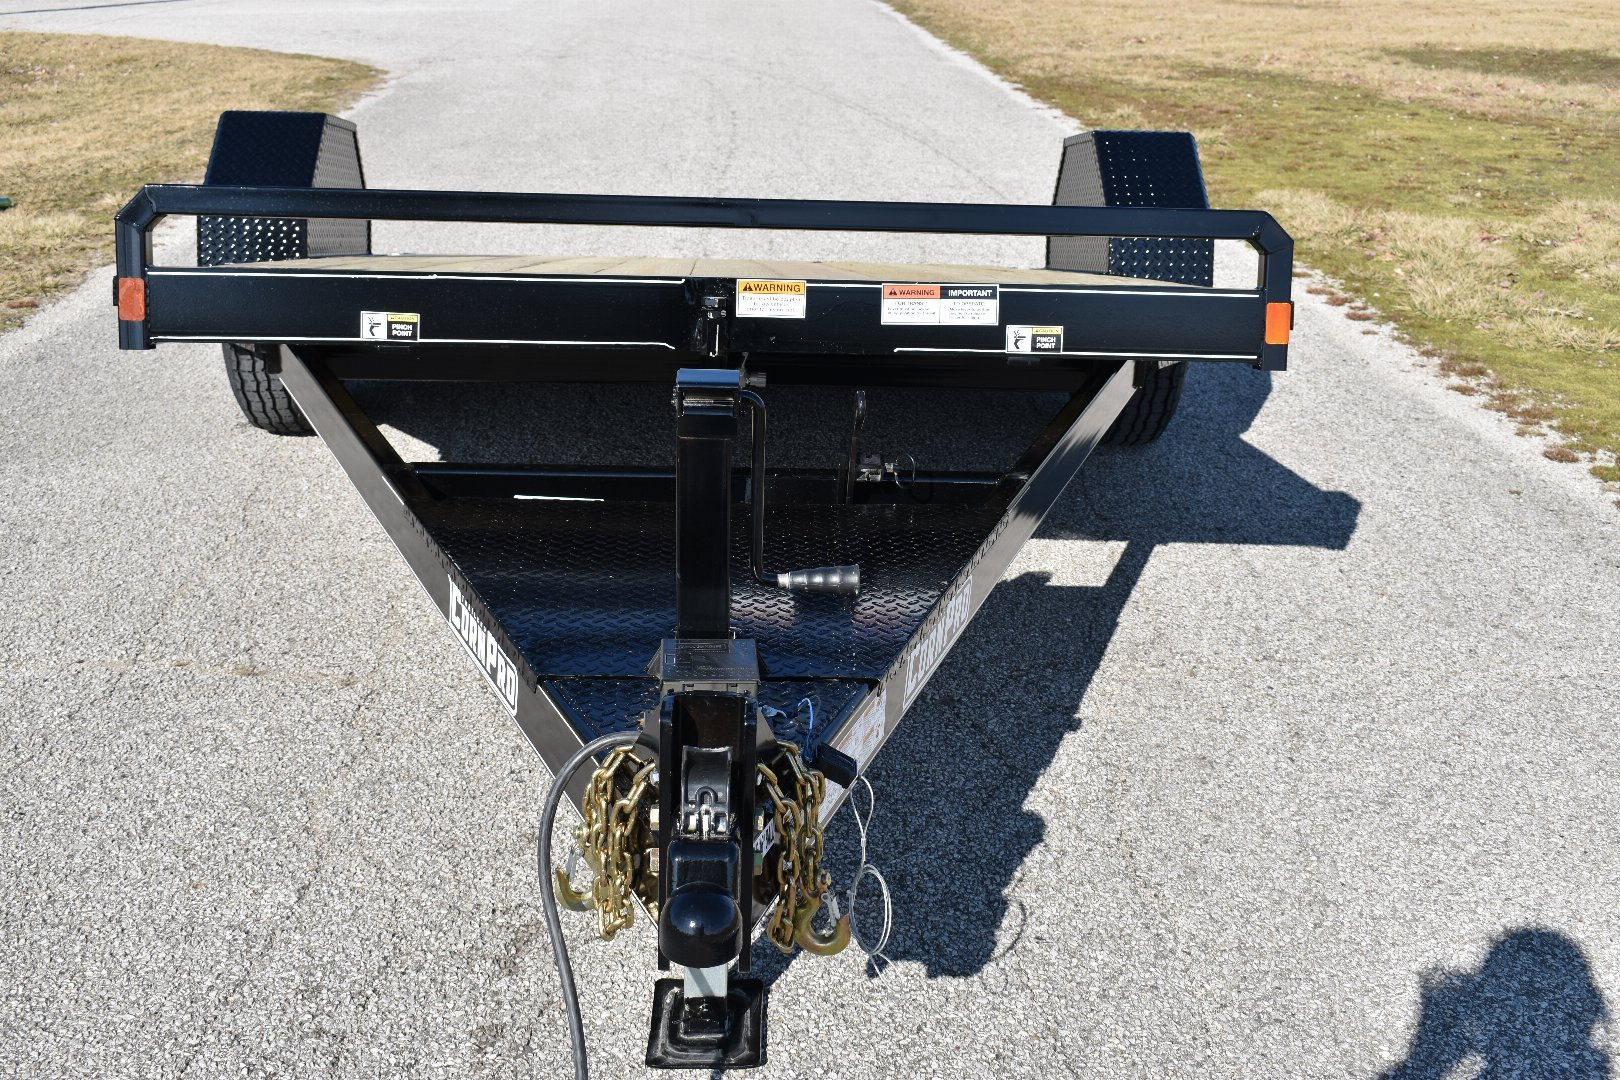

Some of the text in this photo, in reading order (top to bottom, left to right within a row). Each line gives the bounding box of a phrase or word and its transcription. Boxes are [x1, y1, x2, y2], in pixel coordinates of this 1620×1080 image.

[753, 283, 801, 293] WARNING
[948, 289, 993, 297] IMPORTANT
[391, 323, 413, 331] PINCH
